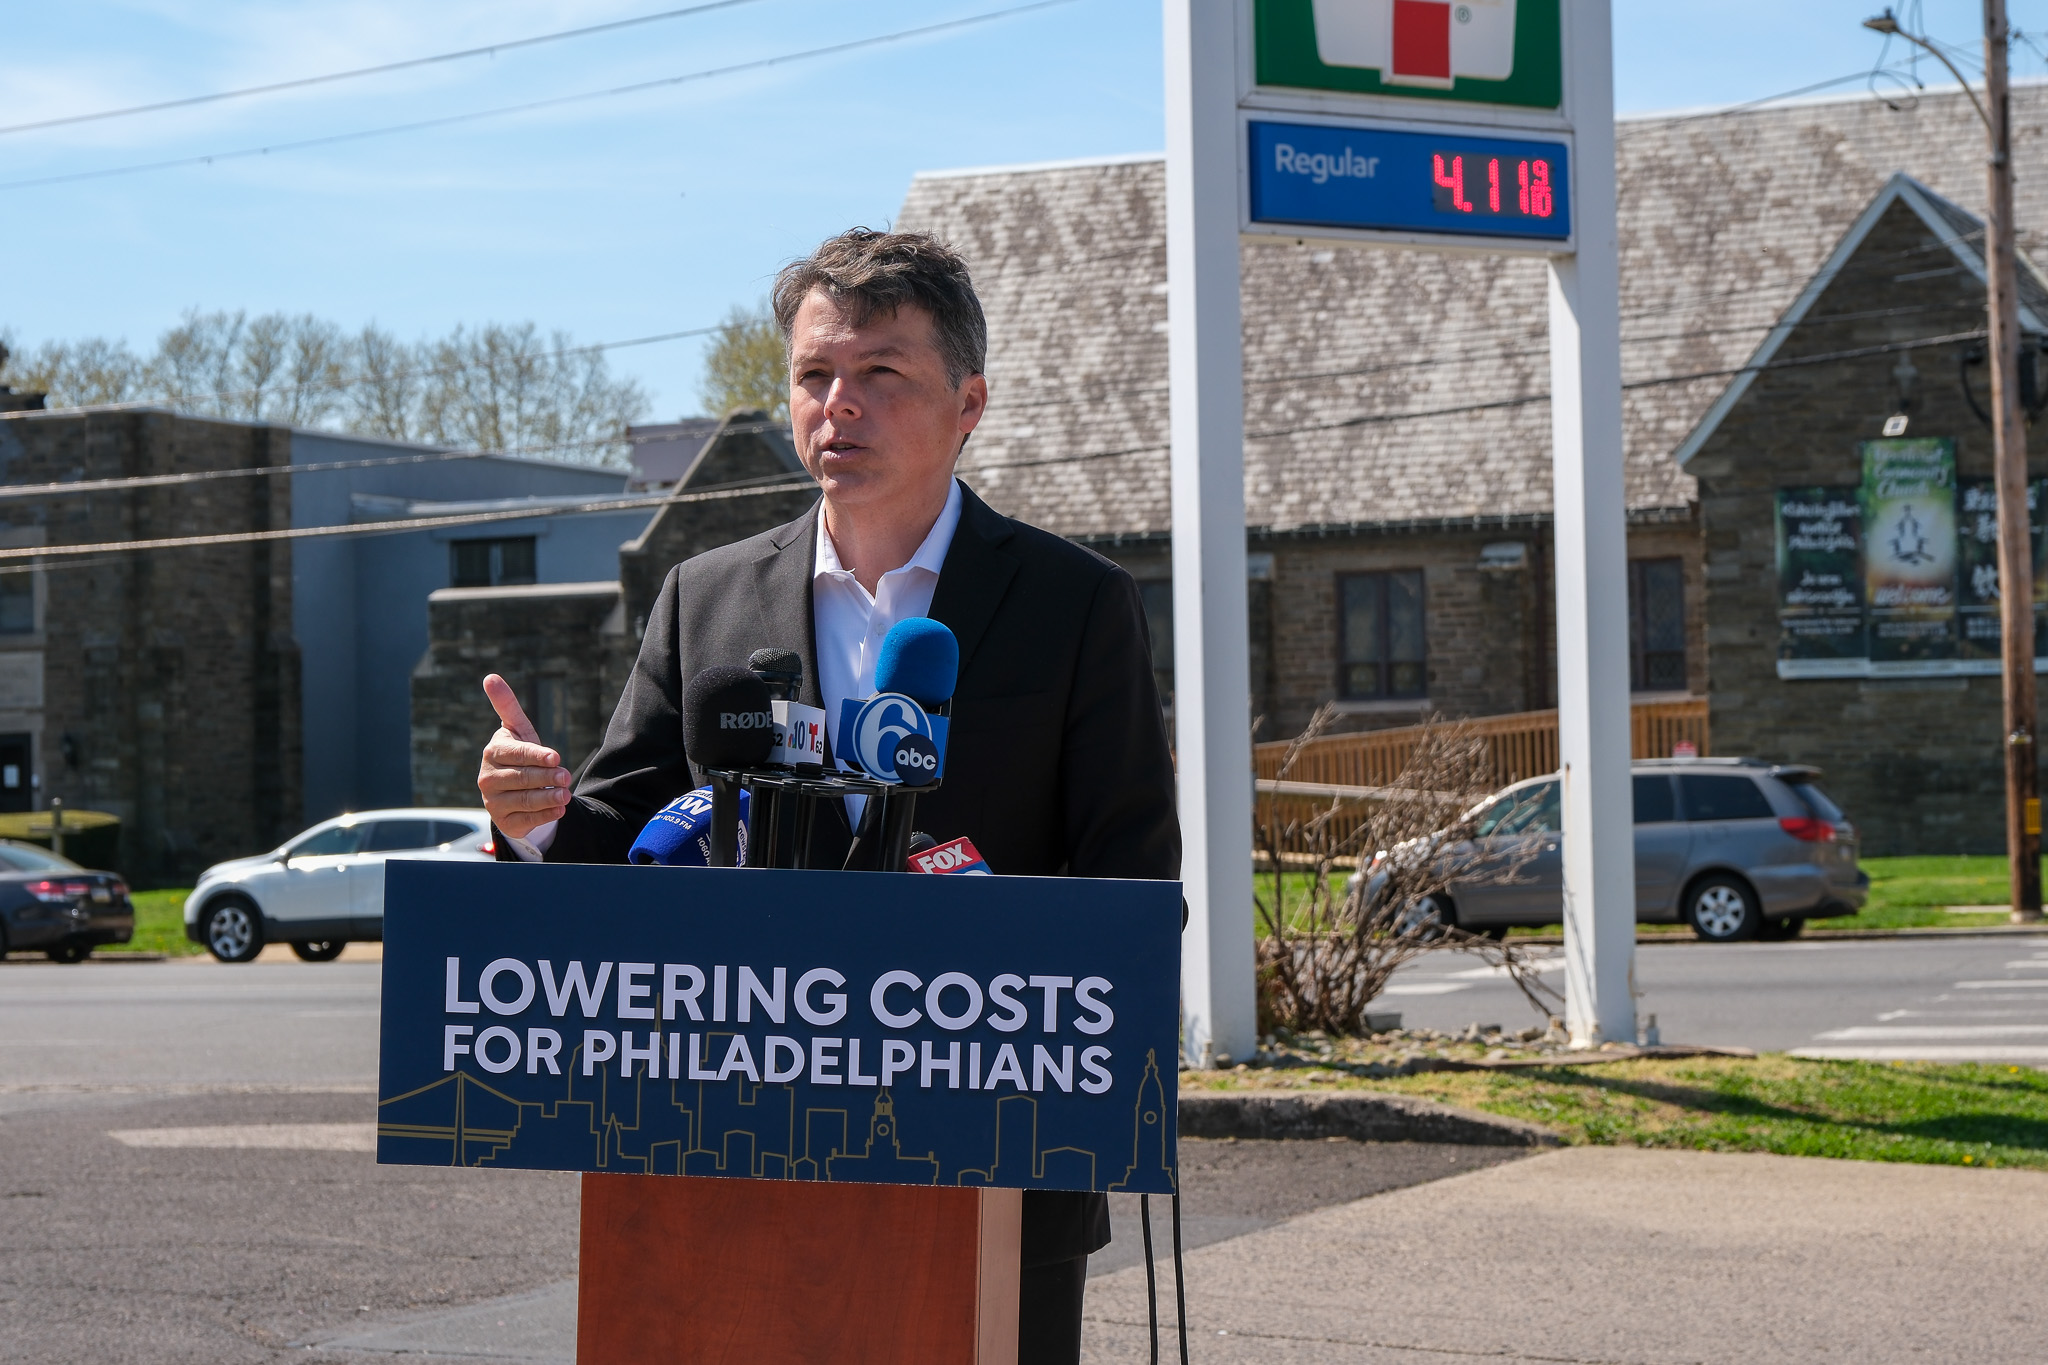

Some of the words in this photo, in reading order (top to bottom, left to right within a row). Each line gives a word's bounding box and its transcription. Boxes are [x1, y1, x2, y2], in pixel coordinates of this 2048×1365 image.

[1275, 143, 1380, 184] Regular
[719, 711, 773, 729] RØDE
[815, 740, 823, 754] 62
[859, 698, 918, 780] 6
[895, 747, 936, 770] abc
[679, 820, 692, 830] FM
[697, 836, 711, 858] 1060
[917, 843, 973, 874] FOX
[445, 956, 848, 1026] LOWERING
[869, 969, 1115, 1035] COSTS
[443, 1024, 563, 1075] FOR
[582, 1029, 1113, 1094] PHILADELPHIANS
